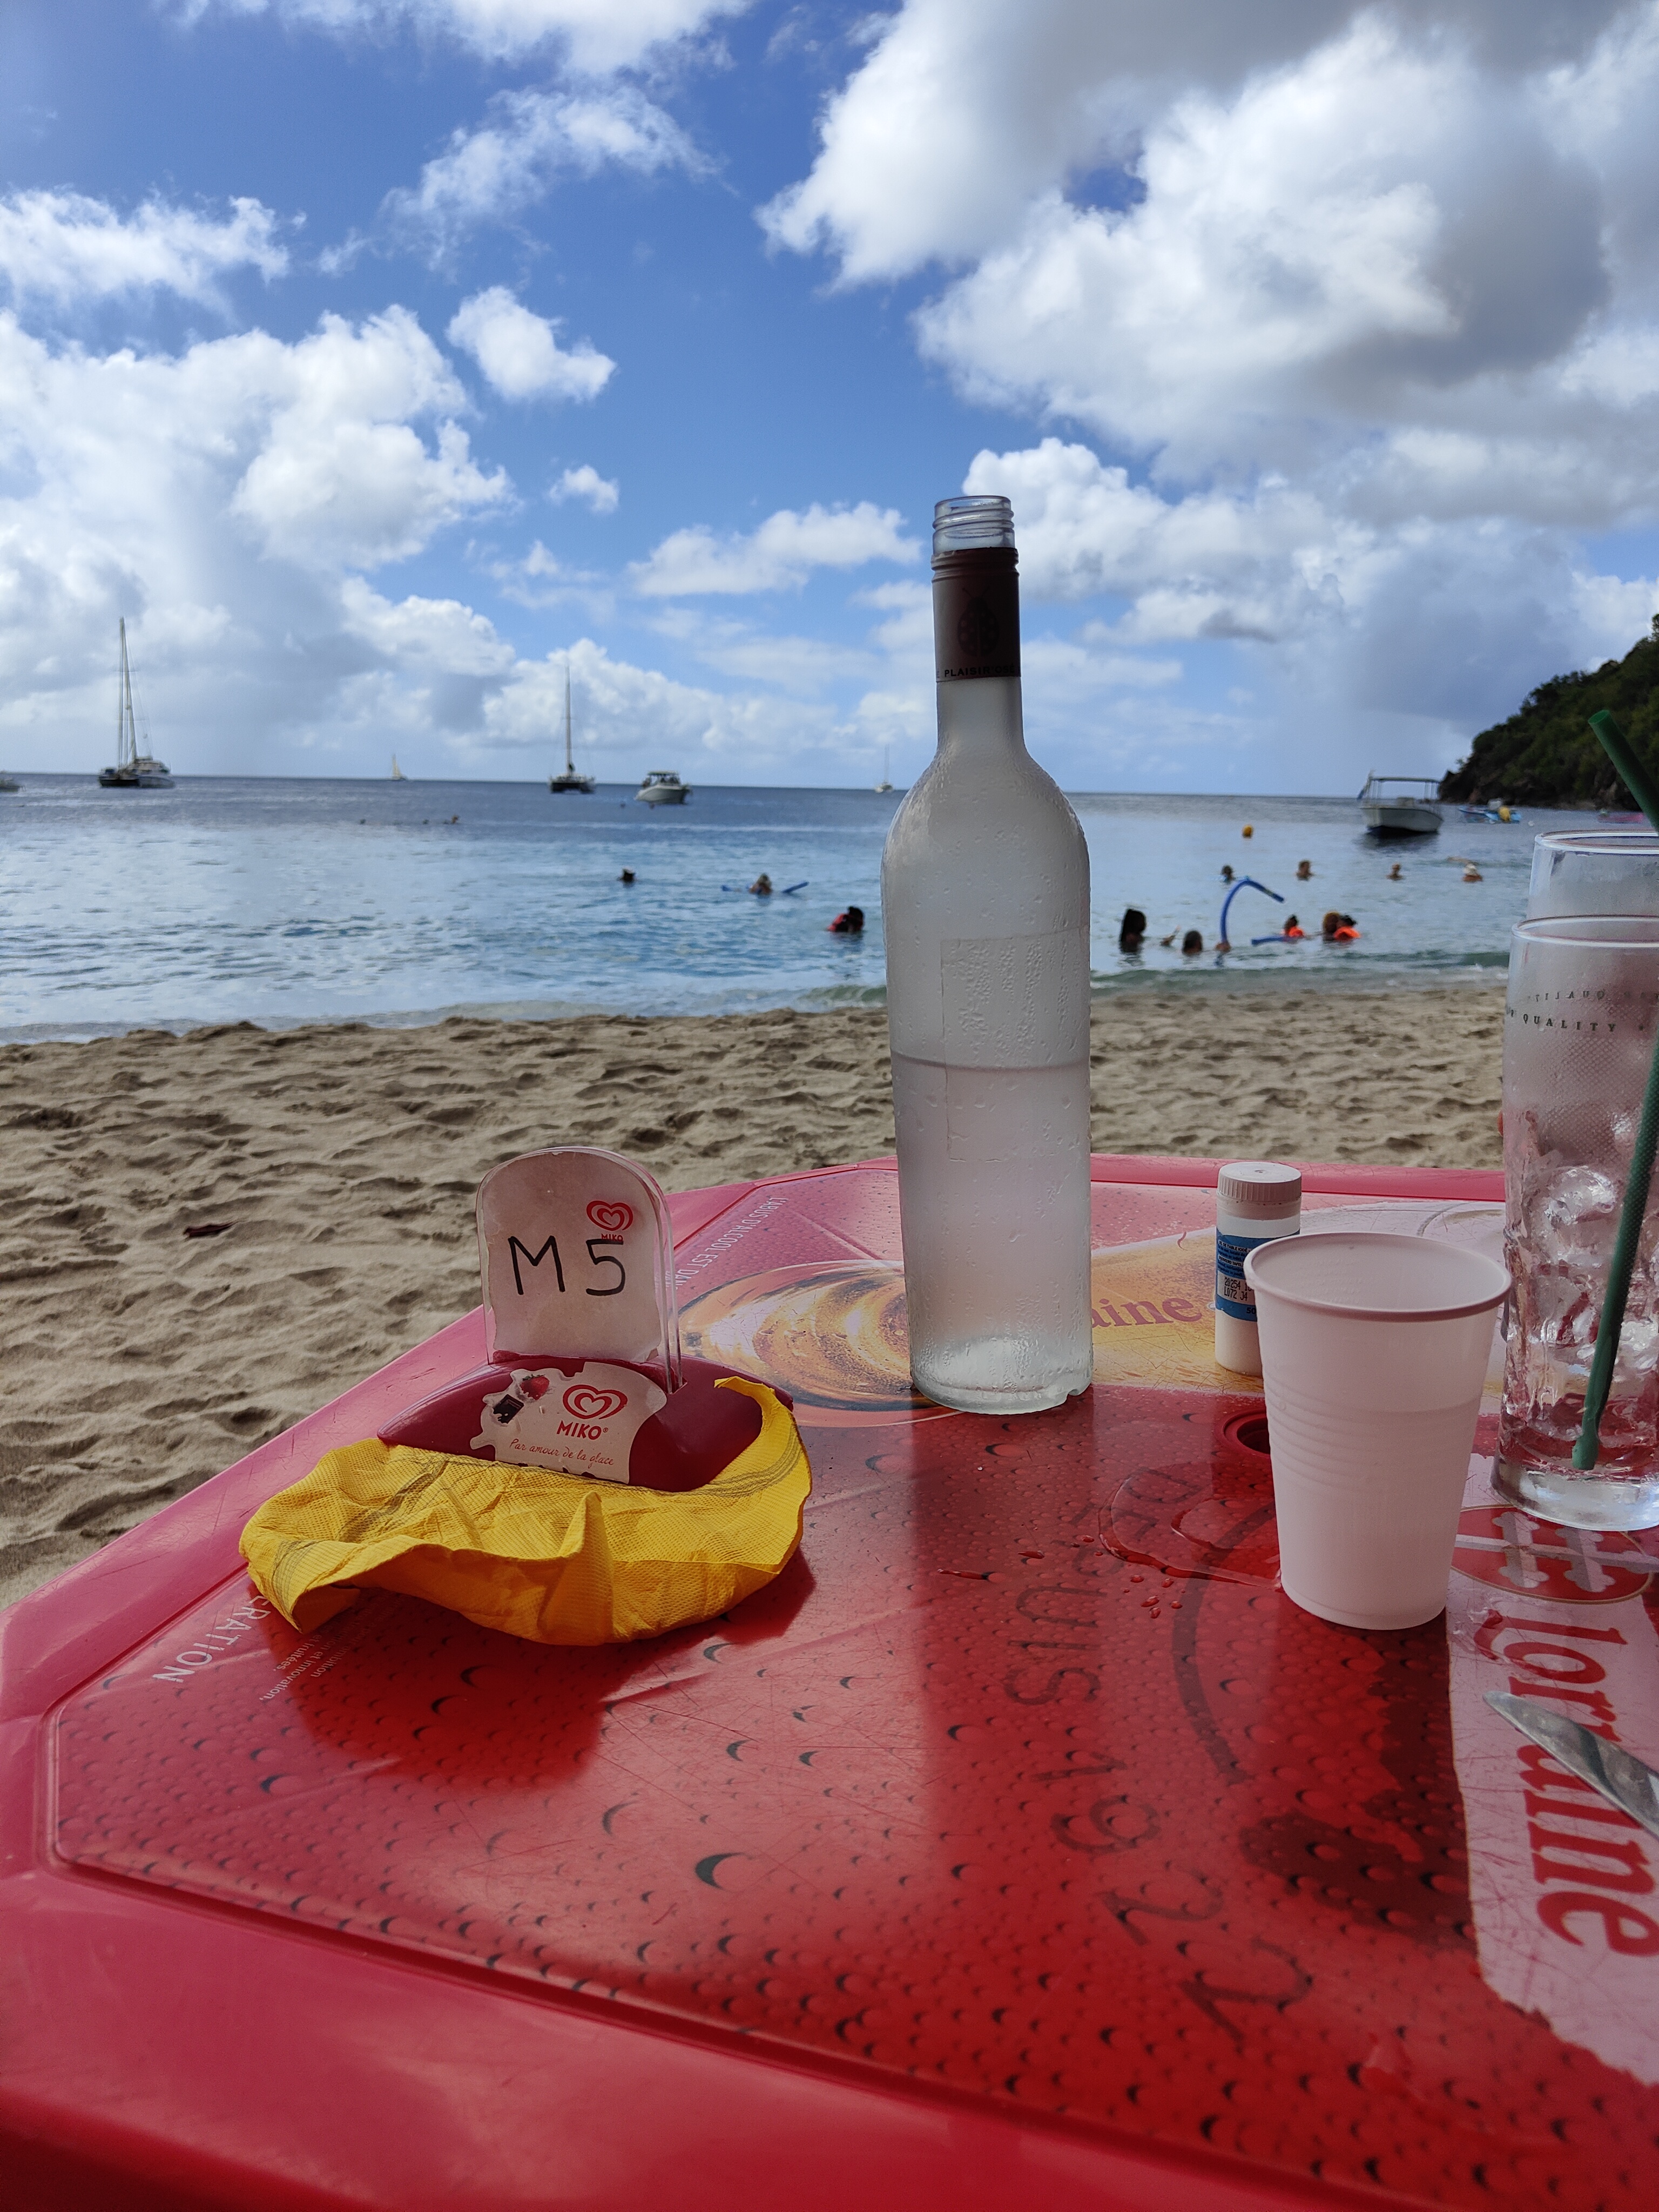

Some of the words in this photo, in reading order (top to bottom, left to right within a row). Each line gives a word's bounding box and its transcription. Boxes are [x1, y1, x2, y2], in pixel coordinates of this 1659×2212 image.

[1523, 1014, 1616, 1032] QUALITY
[601, 1233, 623, 1242] MIKO
[687, 1253, 719, 1268] EST
[509, 1438, 527, 1451] Par
[529, 1445, 559, 1456] amour
[563, 1446, 574, 1459] de
[577, 1449, 586, 1461] la
[588, 1452, 615, 1469] glace
[1473, 1608, 1659, 1958] Loraine
